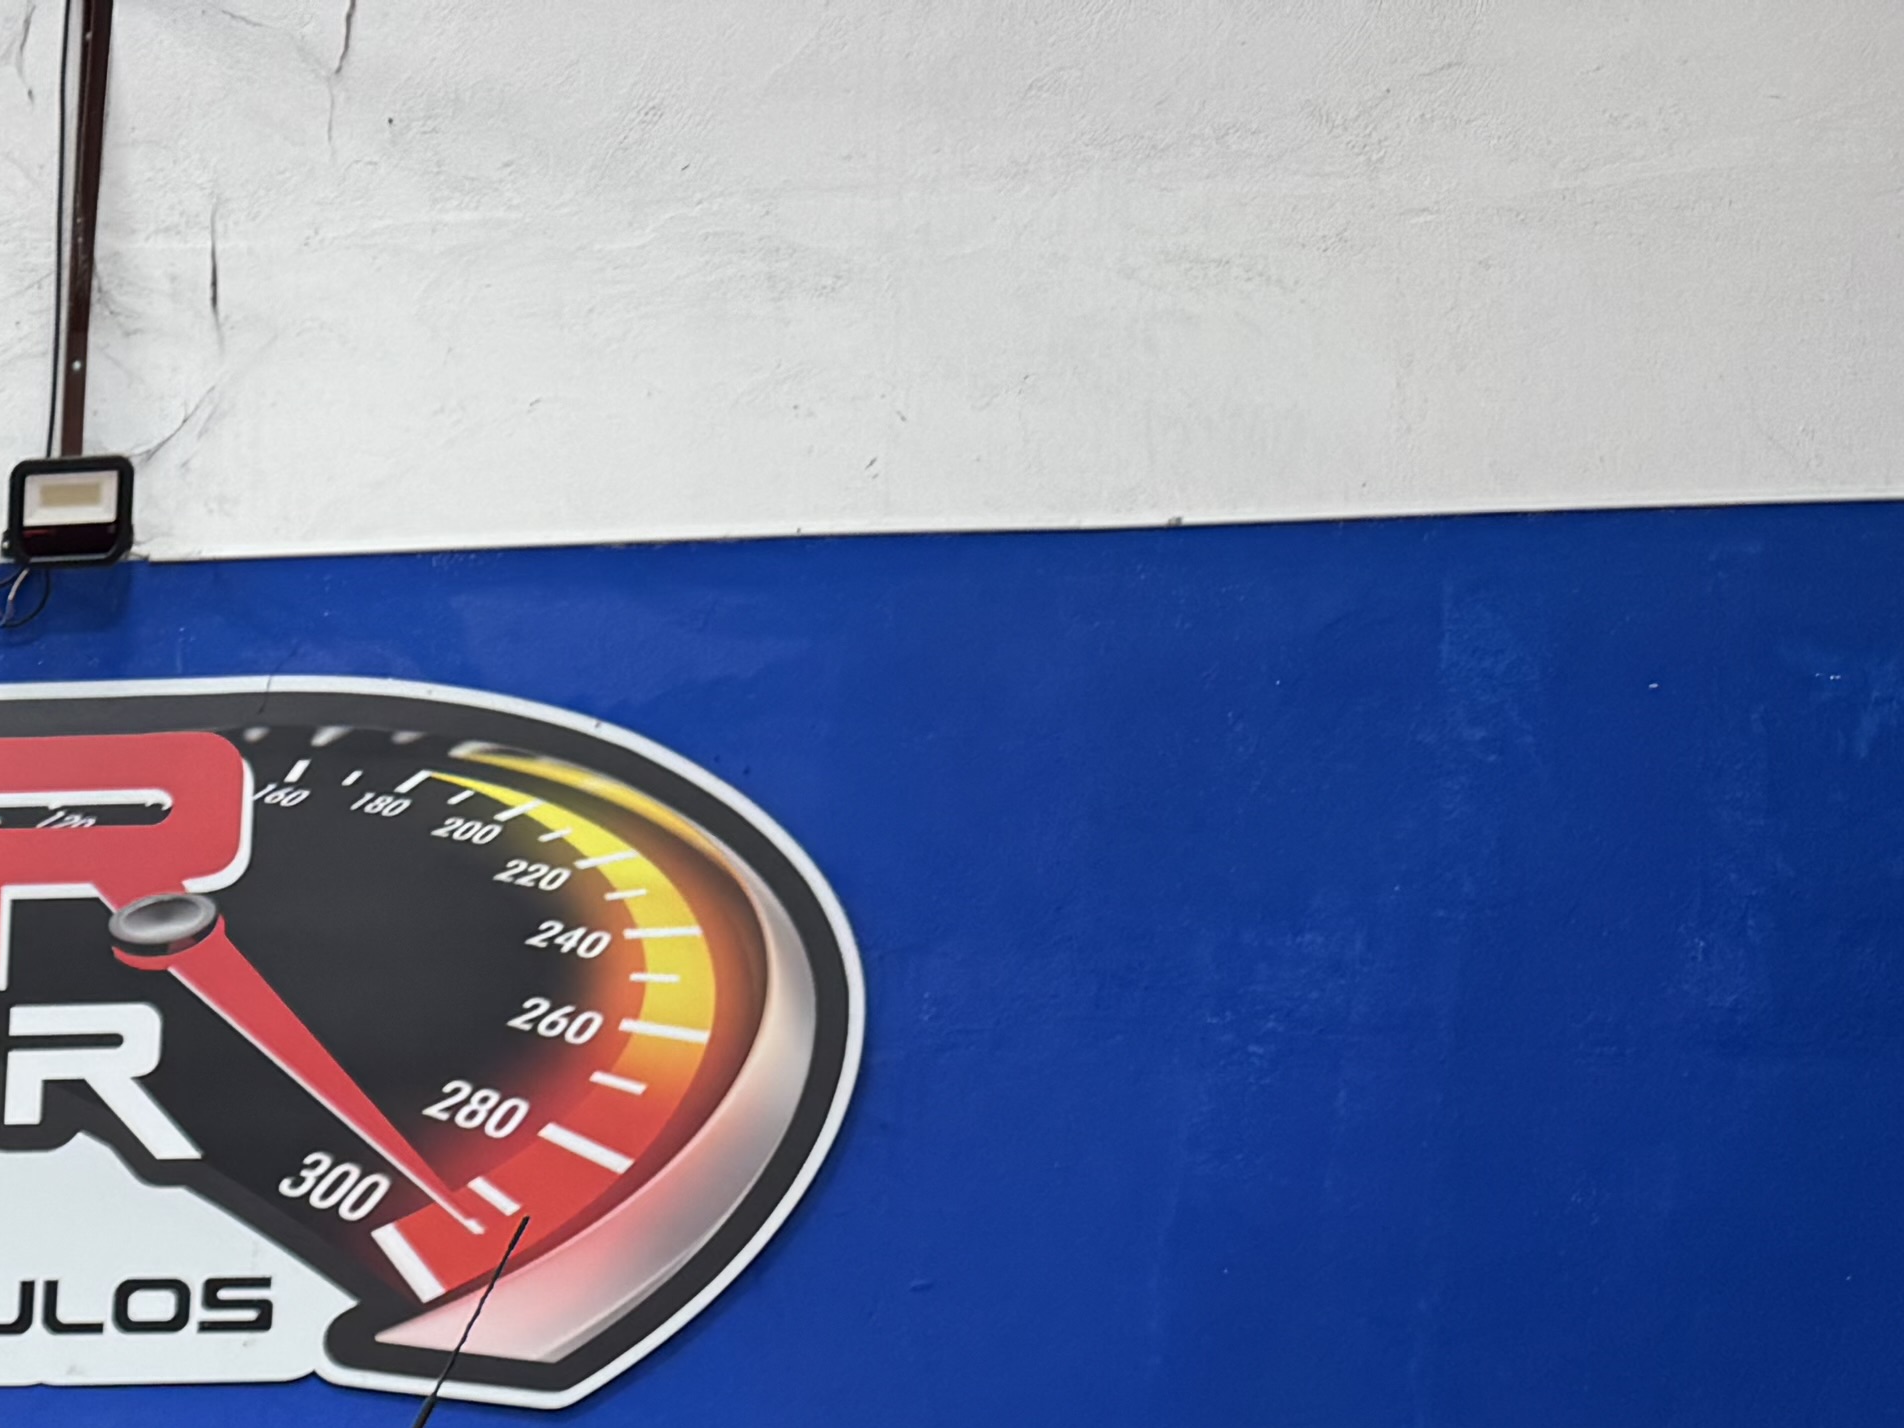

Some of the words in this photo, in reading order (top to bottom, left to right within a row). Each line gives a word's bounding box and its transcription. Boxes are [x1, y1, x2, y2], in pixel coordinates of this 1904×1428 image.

[252, 782, 311, 807] 160
[350, 792, 413, 817] 180
[430, 817, 503, 845] 200
[493, 858, 572, 891] 220
[524, 919, 612, 958] 240
[506, 996, 604, 1045] 260
[422, 1079, 530, 1139] 280
[278, 1151, 390, 1221] 300
